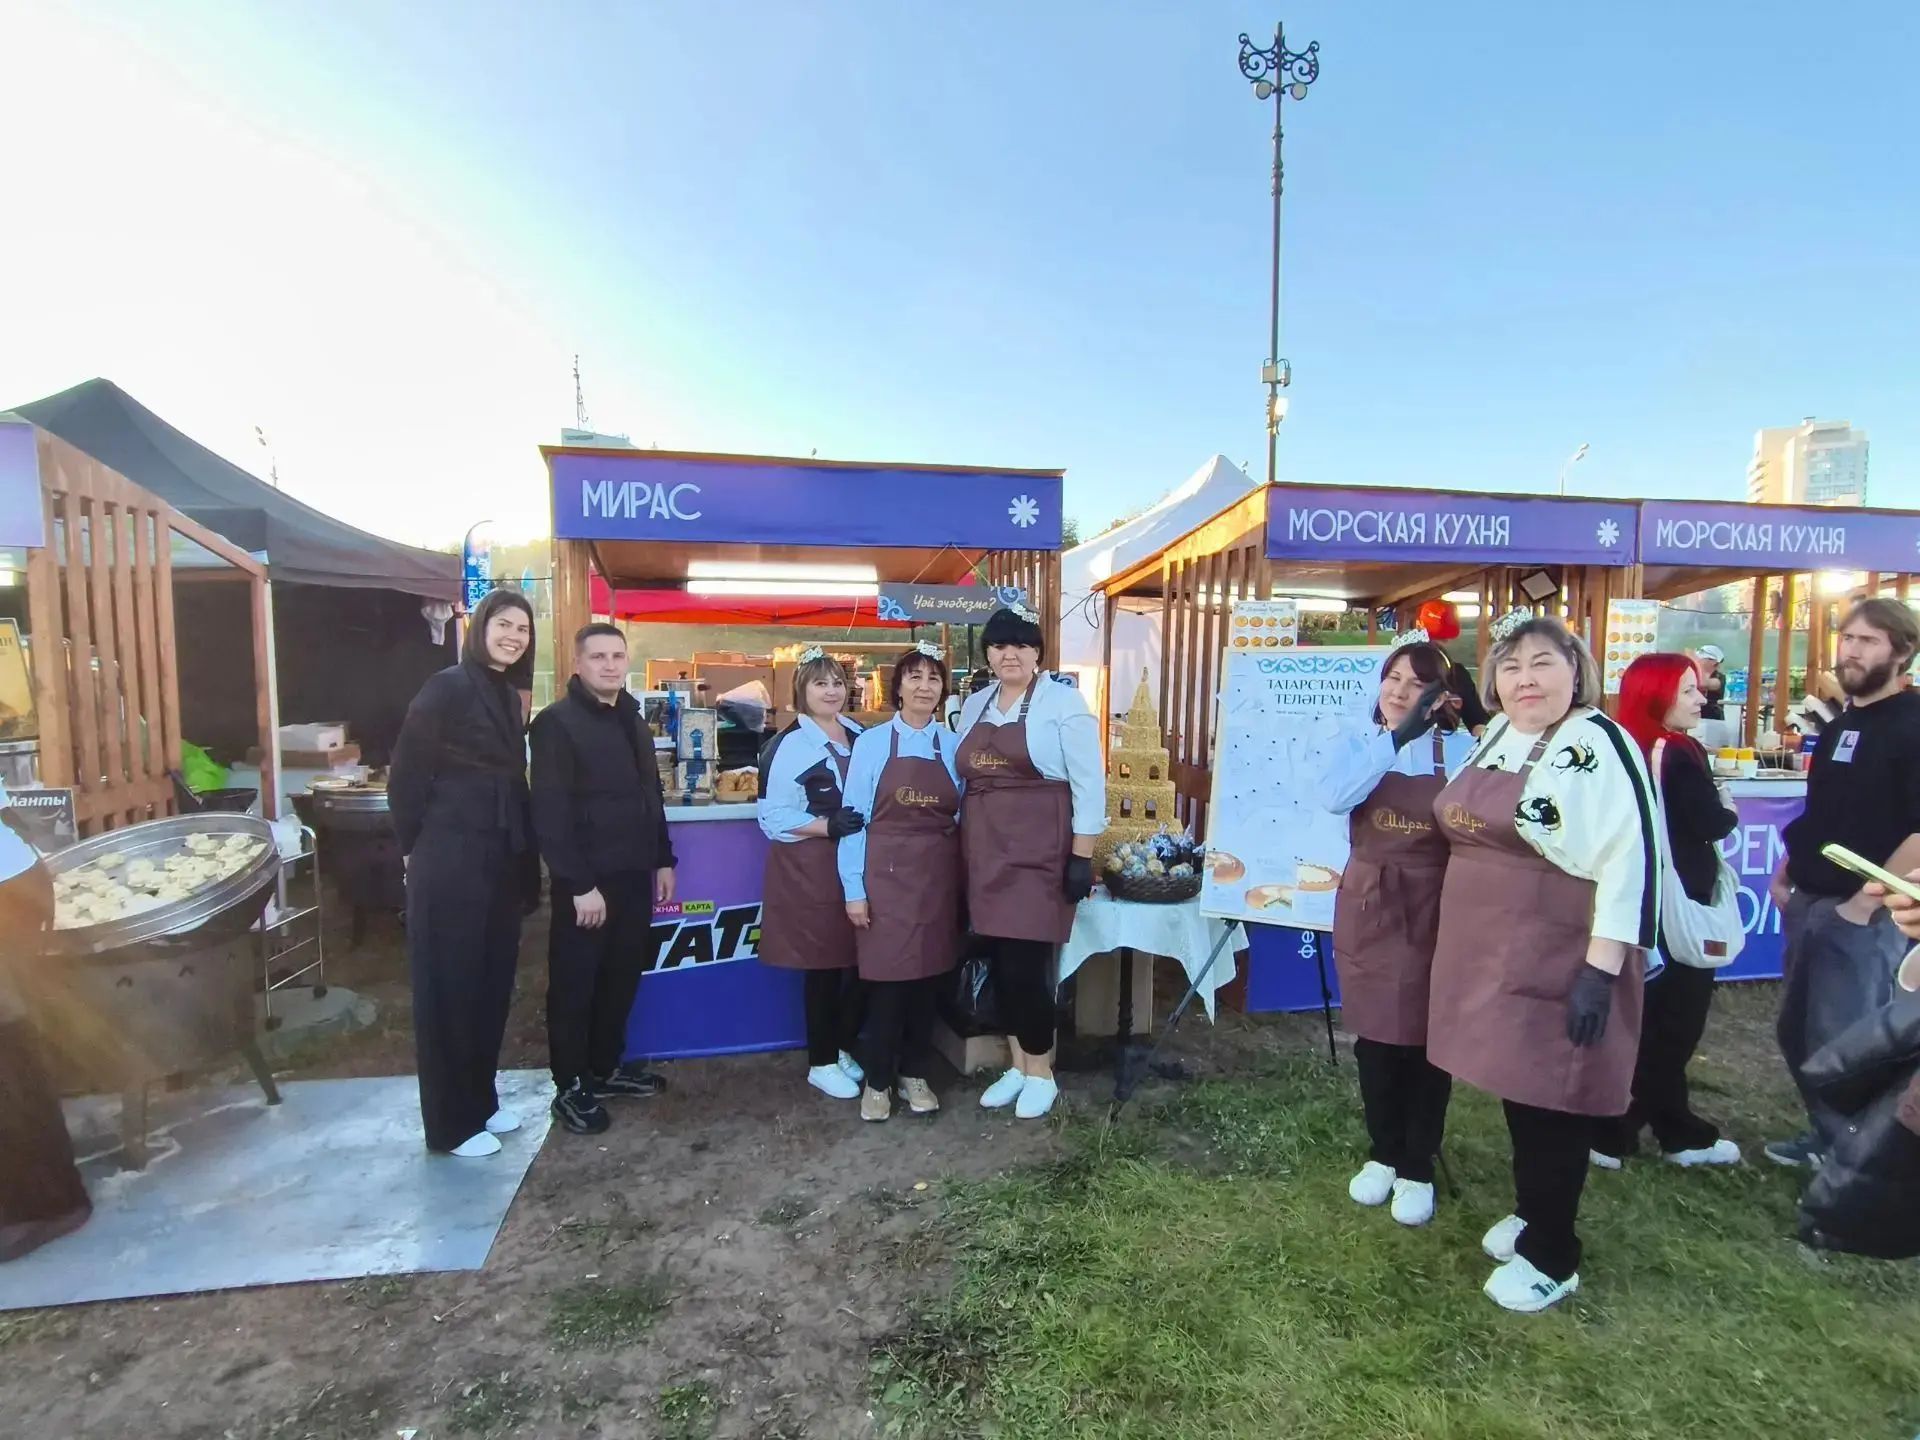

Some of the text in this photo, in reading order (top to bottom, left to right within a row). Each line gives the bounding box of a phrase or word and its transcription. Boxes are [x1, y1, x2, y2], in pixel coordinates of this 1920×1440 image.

[582, 479, 702, 520] МИРАС
[1288, 508, 1511, 545] МОРСКАЯ КУХНЯ
[1656, 519, 1846, 554] МОРСКАЯ КУХНЯ
[913, 595, 996, 612] Чәй эчәбезме?
[1267, 679, 1363, 690] ТАТАРСТАНГА
[685, 903, 711, 911] КАРТА
[1297, 930, 1317, 959] фе
